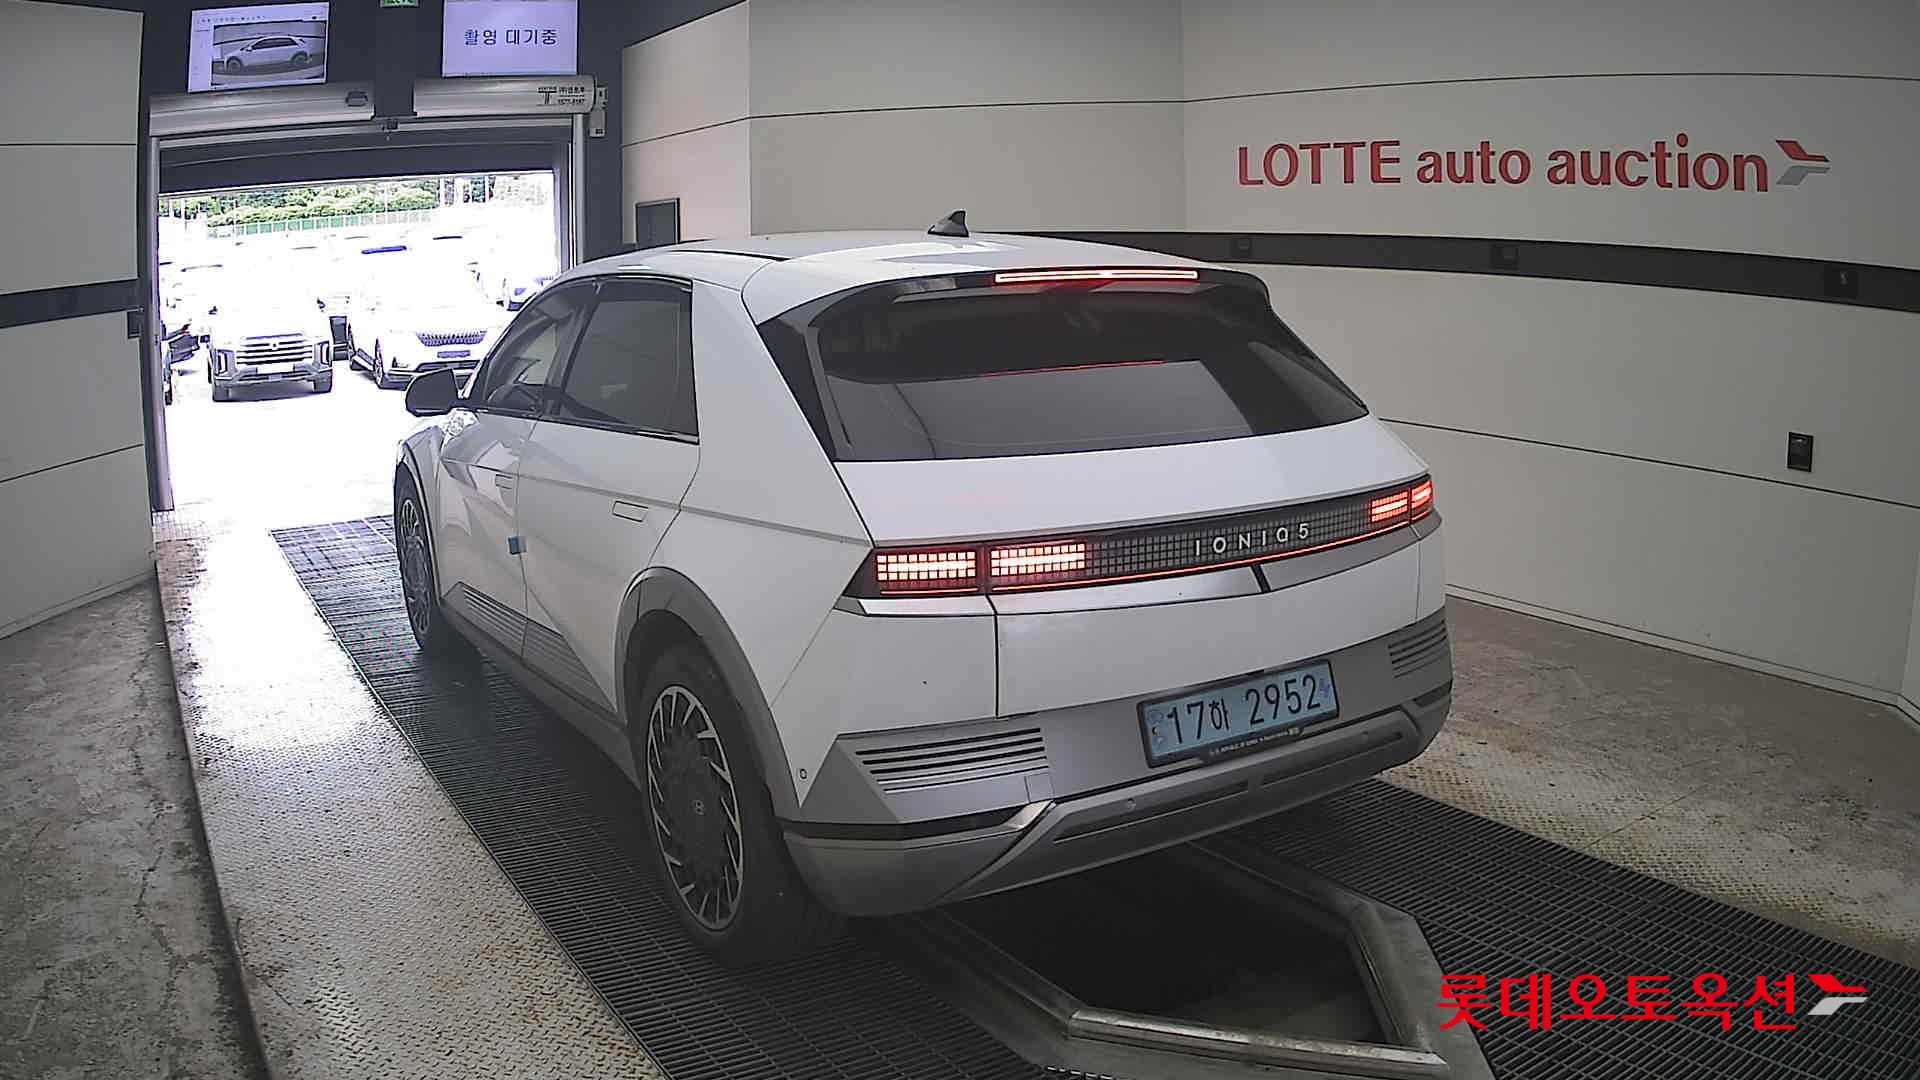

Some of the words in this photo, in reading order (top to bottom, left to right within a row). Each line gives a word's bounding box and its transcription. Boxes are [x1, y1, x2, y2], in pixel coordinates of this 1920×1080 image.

[464, 29, 497, 46] 촬영
[505, 29, 558, 46] 대기중
[1238, 140, 1401, 186] LOTTE
[1416, 140, 1532, 186] auto
[1546, 132, 1770, 193] auction
[1166, 697, 1230, 744] 17하
[1244, 674, 1321, 726] 2952
